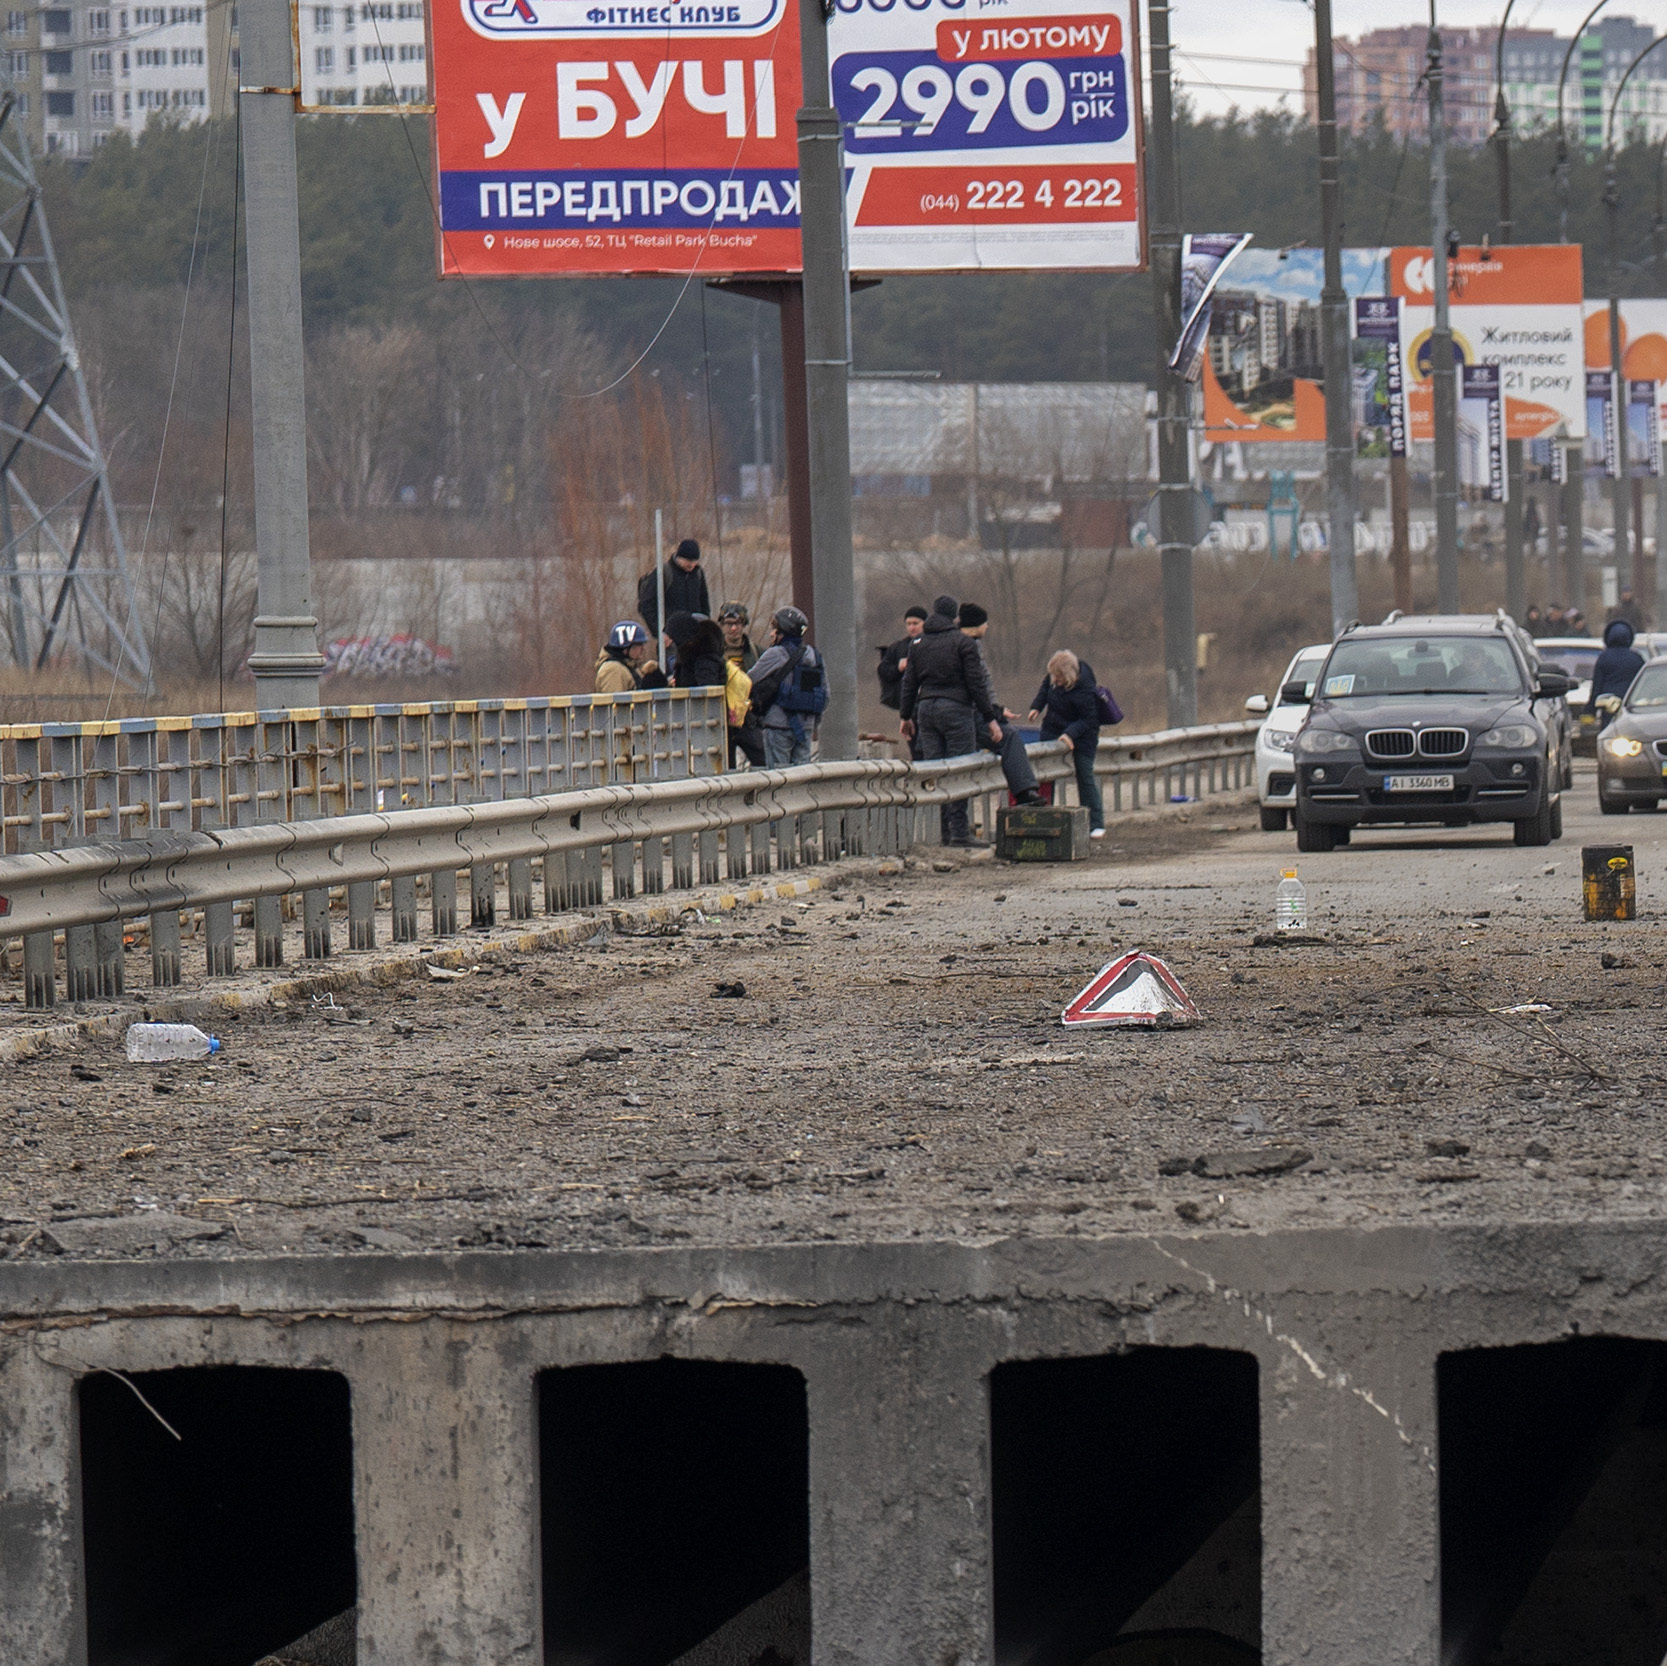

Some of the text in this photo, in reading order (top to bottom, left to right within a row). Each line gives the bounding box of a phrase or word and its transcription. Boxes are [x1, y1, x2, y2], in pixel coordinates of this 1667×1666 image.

[586, 6, 741, 24] ФІТНЕС КЛУБ
[952, 23, 1111, 58] у лютому
[1070, 70, 1114, 93] грн
[475, 59, 777, 159] у БУЧІ
[850, 61, 1066, 138] 2990
[1071, 95, 1116, 125] рік
[920, 178, 1123, 213] (044) 222 4 222
[504, 235, 540, 248] Нове
[1482, 327, 1573, 344] Житловий
[1387, 343, 1401, 385] ПАРК
[1482, 353, 1567, 367] комплекс
[1531, 376, 1572, 392] року
[615, 625, 637, 645] TV
